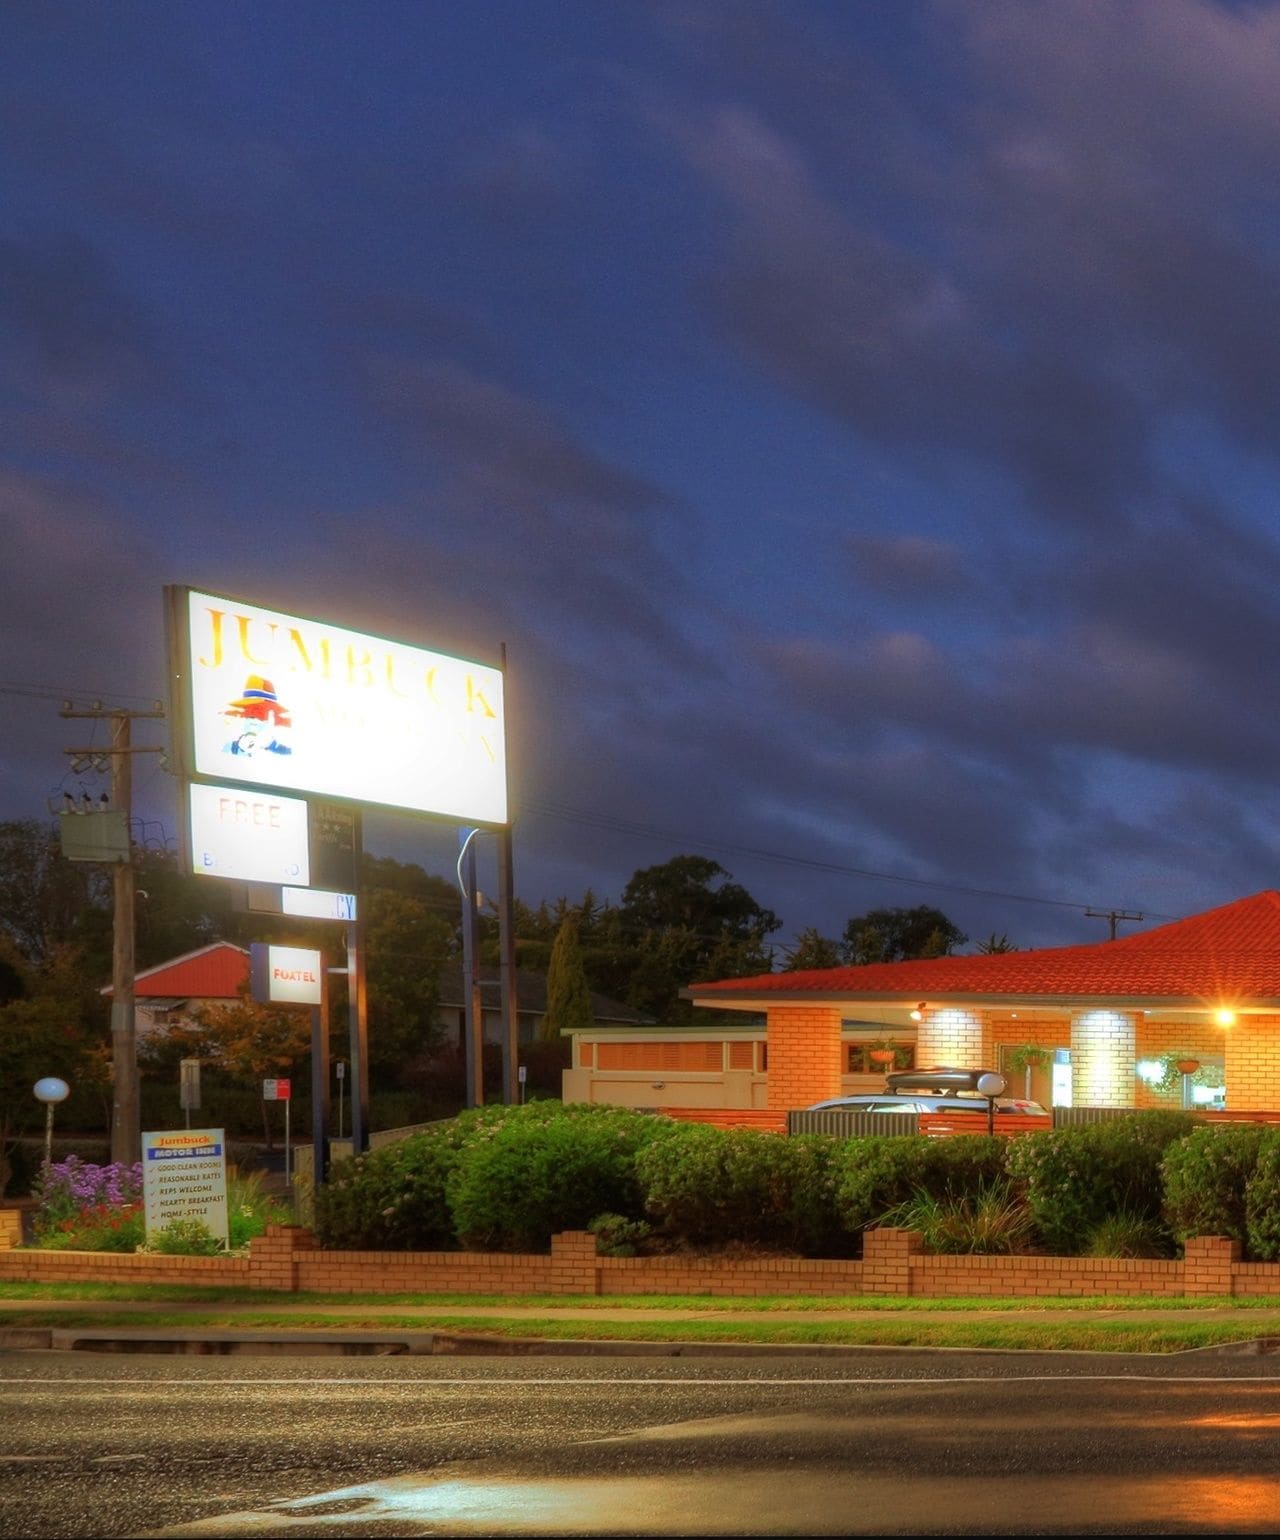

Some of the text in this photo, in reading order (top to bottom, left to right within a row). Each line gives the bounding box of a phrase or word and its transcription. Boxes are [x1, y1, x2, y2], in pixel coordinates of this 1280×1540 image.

[199, 608, 497, 718] JUMBUCK
[219, 798, 281, 828] FREE
[273, 968, 316, 983] FOXTEL
[160, 1136, 209, 1146] Jumbuck
[155, 1147, 215, 1157] MOTOR INN
[158, 1163, 176, 1171] GOOD
[178, 1162, 198, 1170] CLEAN
[160, 1172, 221, 1183] REASONABLE RATES
[180, 1185, 212, 1193] WELCOME
[160, 1195, 224, 1206] HEARTY BREAKFAST
